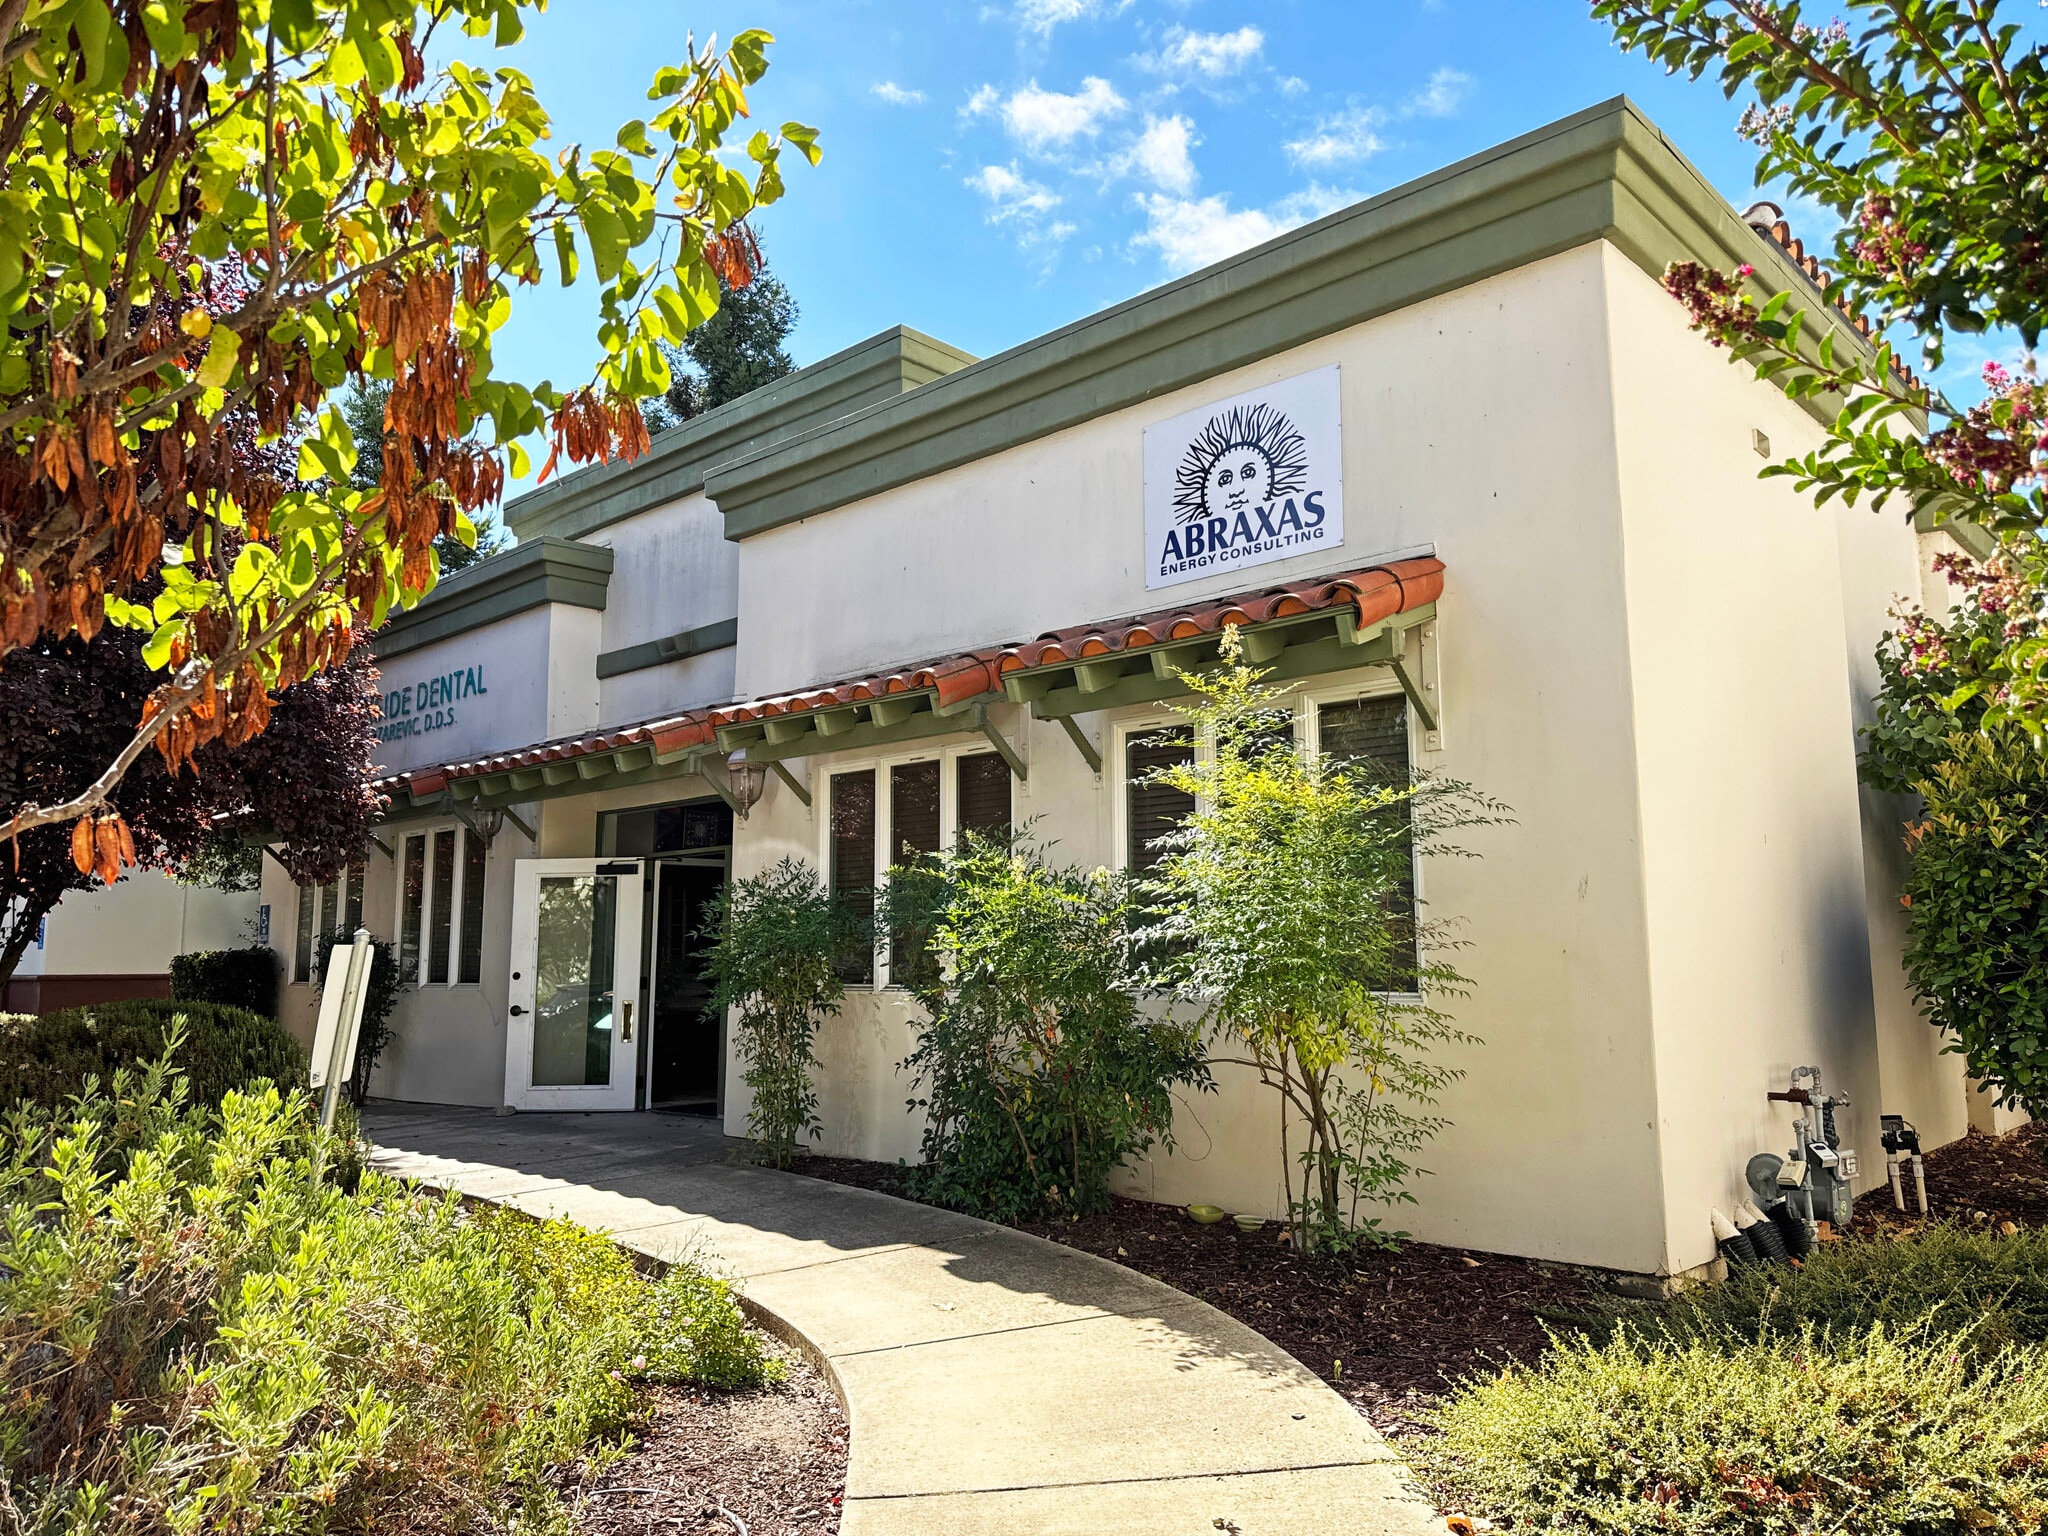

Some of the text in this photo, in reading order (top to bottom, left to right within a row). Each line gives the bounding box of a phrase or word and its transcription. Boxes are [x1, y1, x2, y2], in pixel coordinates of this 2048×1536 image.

[1160, 490, 1326, 565] ABRAXAS
[1160, 527, 1325, 577] ENERGY CONSULTING
[416, 664, 488, 712] DENTAL
[424, 706, 458, 732] D.D.S.
